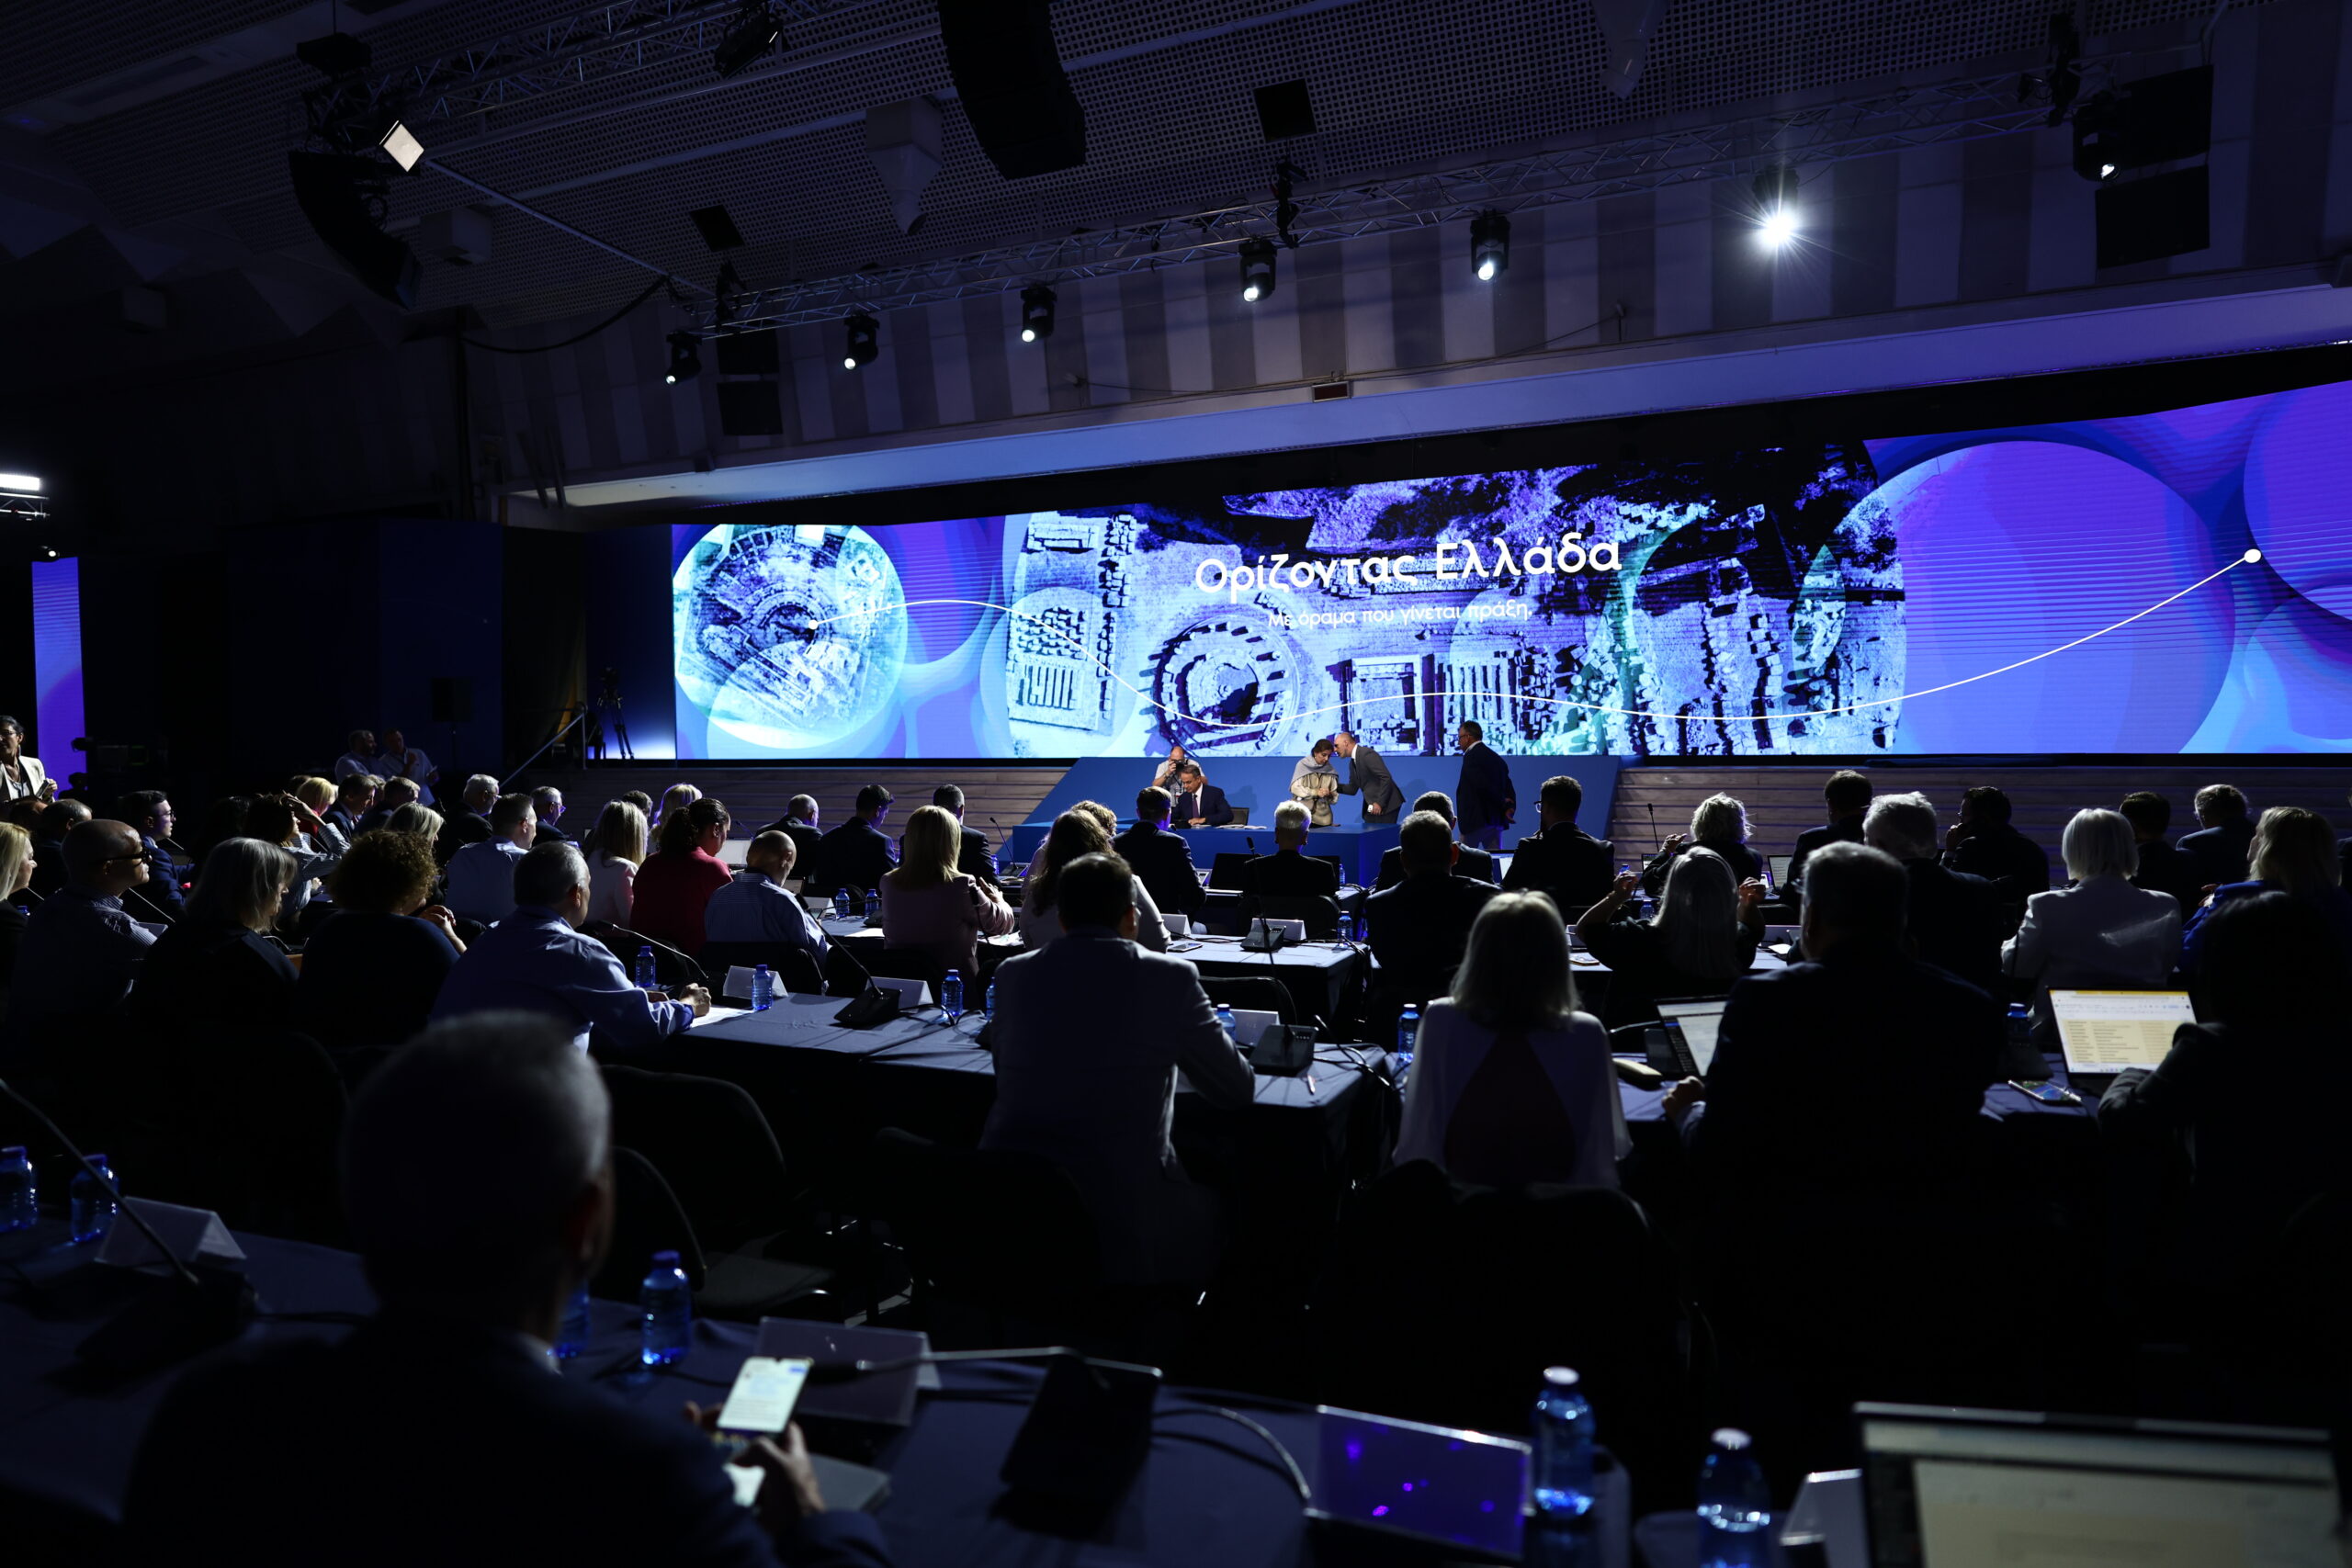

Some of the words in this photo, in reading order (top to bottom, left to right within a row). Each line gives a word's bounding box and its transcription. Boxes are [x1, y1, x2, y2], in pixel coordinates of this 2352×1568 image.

[1195, 553, 1419, 604] Ορίζοντας
[1436, 532, 1623, 580] Ελλάδα
[1268, 612, 1294, 627] Με
[1297, 610, 1356, 629] όραμα
[1362, 609, 1395, 623] που
[1400, 605, 1462, 626] γίνεται
[1467, 599, 1533, 623] πράξη.
